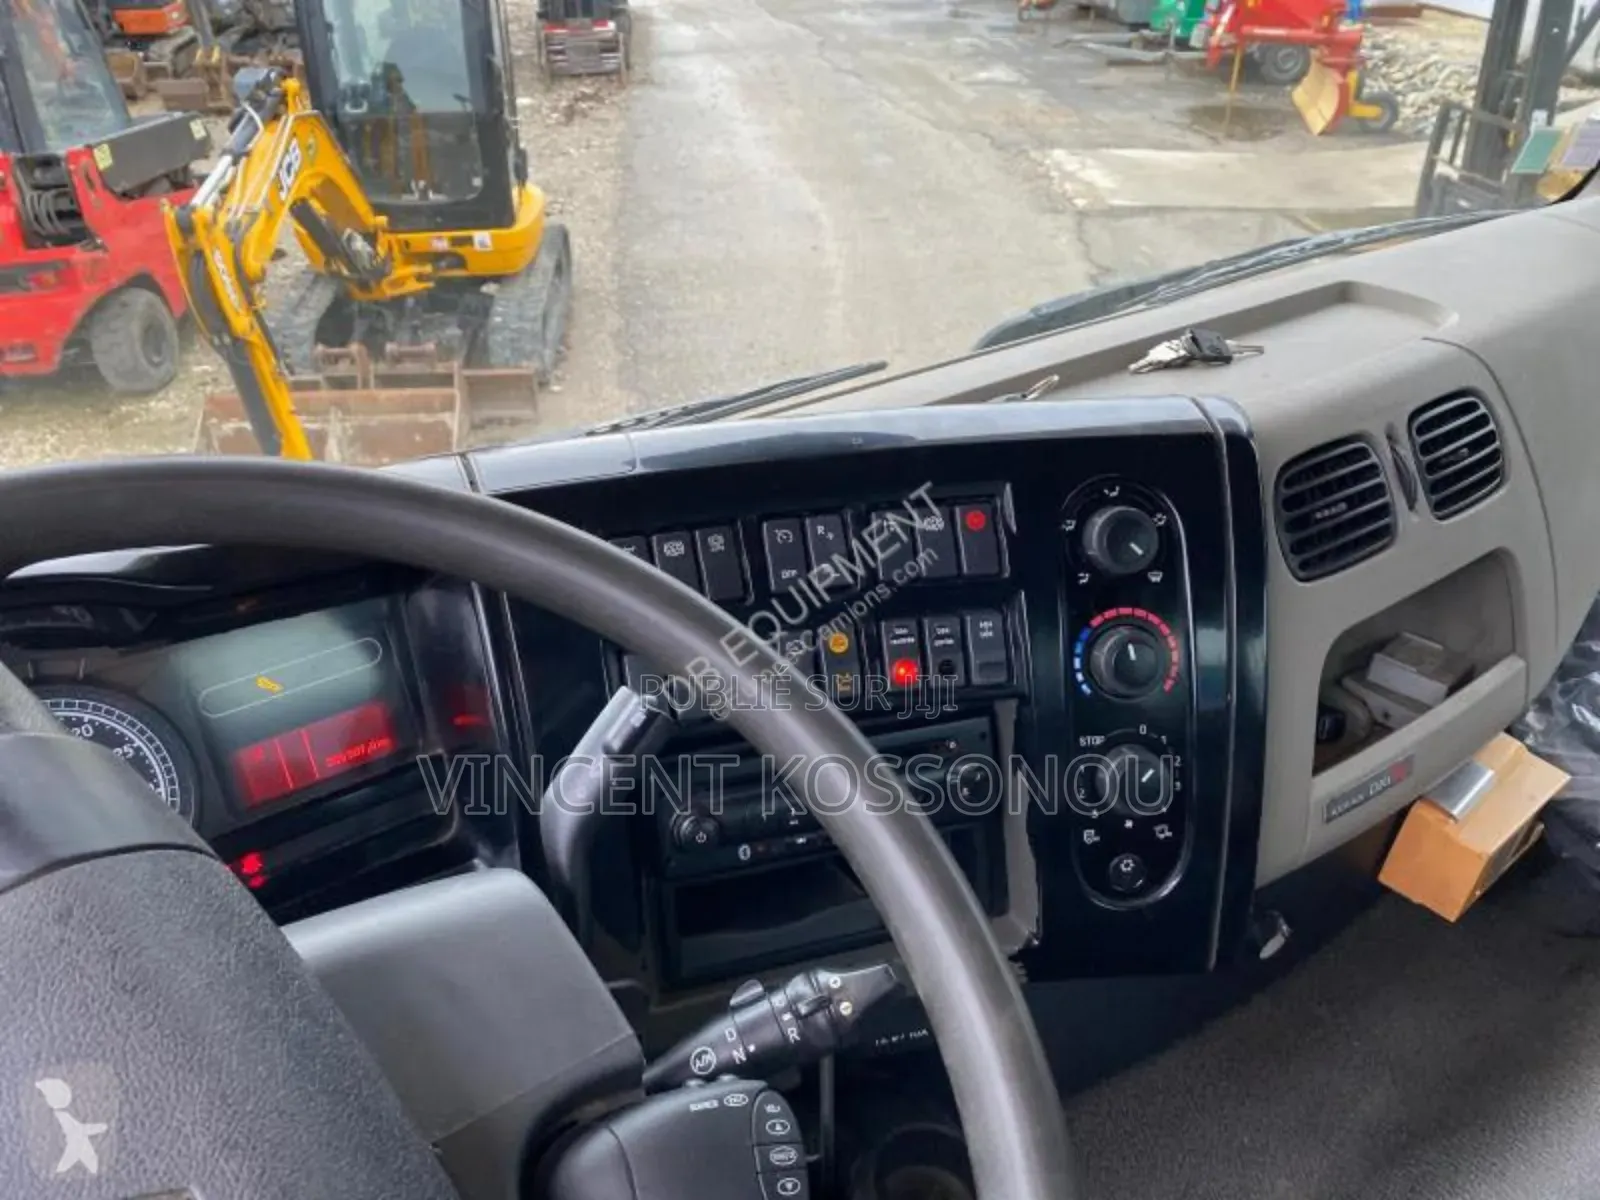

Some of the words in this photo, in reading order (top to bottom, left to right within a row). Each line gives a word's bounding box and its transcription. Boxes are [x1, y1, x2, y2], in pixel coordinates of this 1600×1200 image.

[278, 137, 302, 202] JCB
[1079, 735, 1106, 747] STOP
[724, 1027, 737, 1043] D
[787, 1027, 801, 1043] R
[732, 1047, 747, 1065] N
